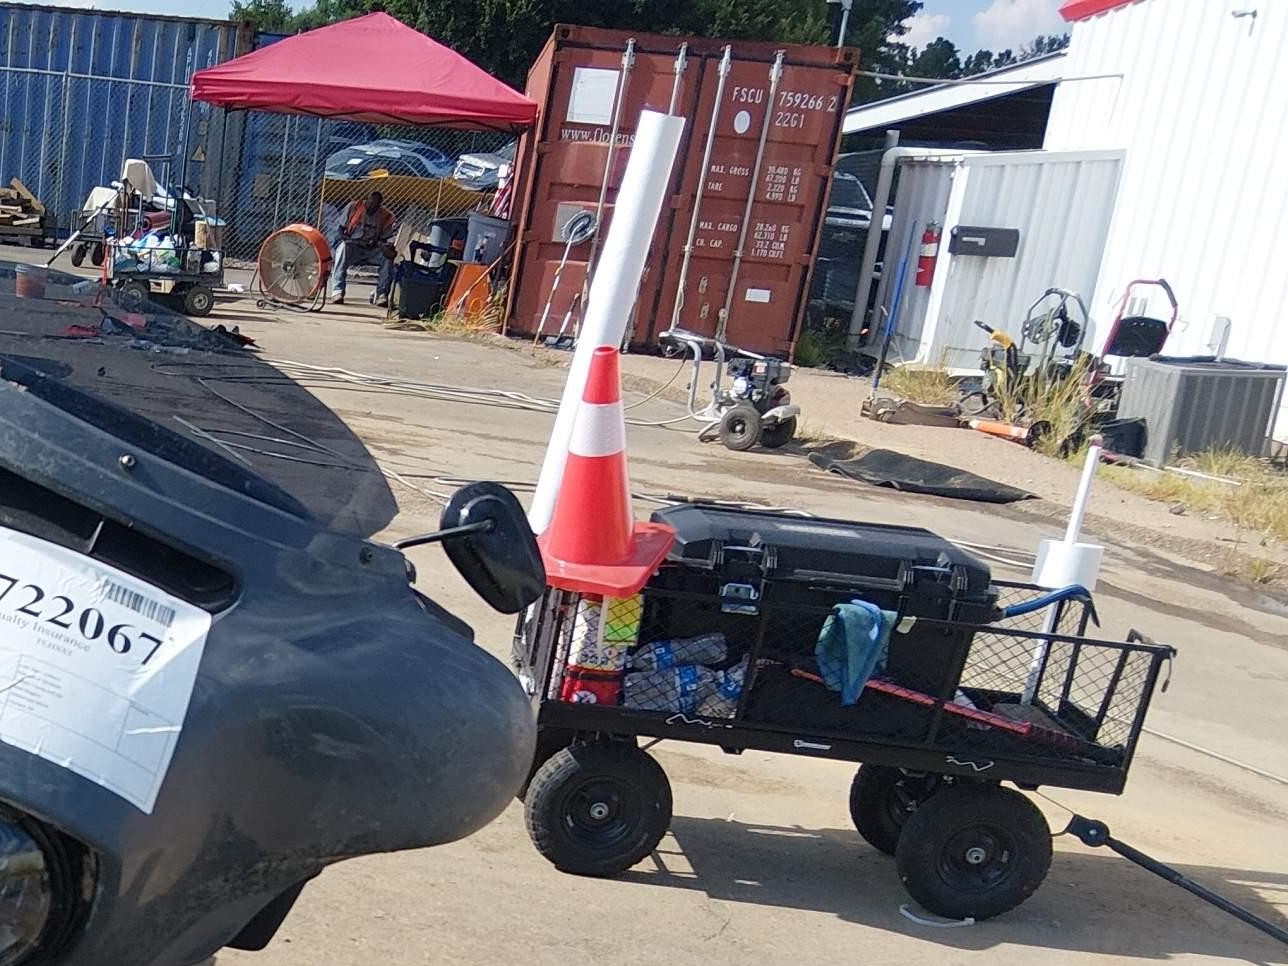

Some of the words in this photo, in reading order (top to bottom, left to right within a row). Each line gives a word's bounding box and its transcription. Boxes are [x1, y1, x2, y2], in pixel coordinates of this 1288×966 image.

[732, 87, 764, 104] FSCU
[779, 91, 824, 110] 759266
[826, 96, 838, 112] 2
[775, 112, 805, 128] 22G1
[561, 128, 637, 145] www.floens
[711, 165, 726, 174] MAX.
[729, 166, 749, 176] GROSS
[793, 168, 801, 176] KG
[791, 176, 800, 185] LB
[708, 182, 723, 191] TARE
[790, 185, 798, 193] KG
[787, 193, 796, 202] LB
[699, 221, 714, 230] MAX.
[718, 222, 738, 232] CARGO
[781, 225, 789, 233] KG
[779, 233, 788, 241] LB
[710, 239, 723, 248] CAP.
[32, 619, 91, 652] Insurance
